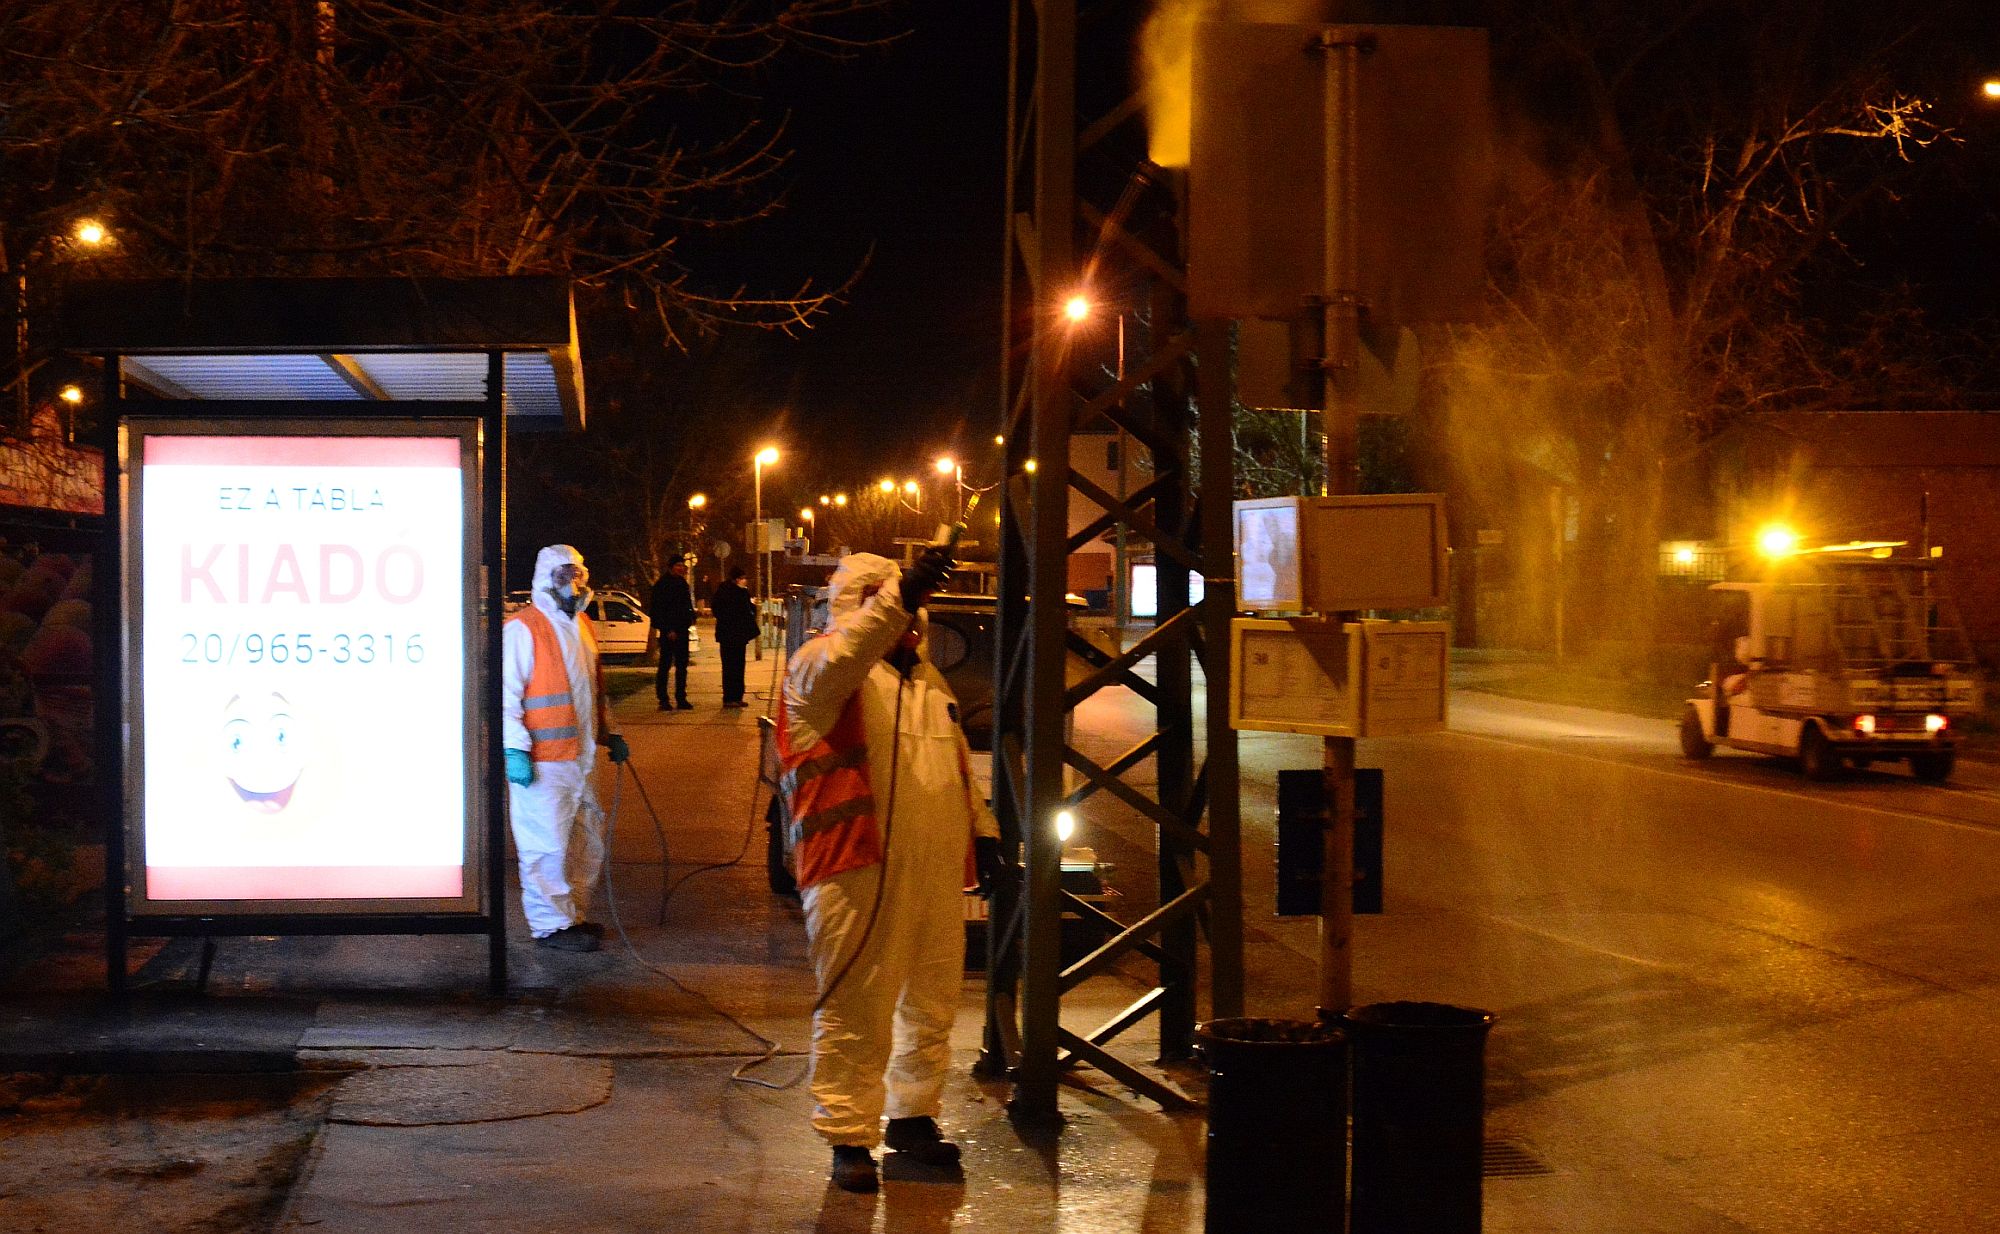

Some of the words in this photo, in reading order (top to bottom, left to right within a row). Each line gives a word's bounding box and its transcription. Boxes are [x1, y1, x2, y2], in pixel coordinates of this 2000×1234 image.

[219, 487, 252, 510] EZ
[265, 487, 281, 510] A
[181, 529, 424, 603] KIADÓ
[181, 633, 424, 665] 20/965-3316
